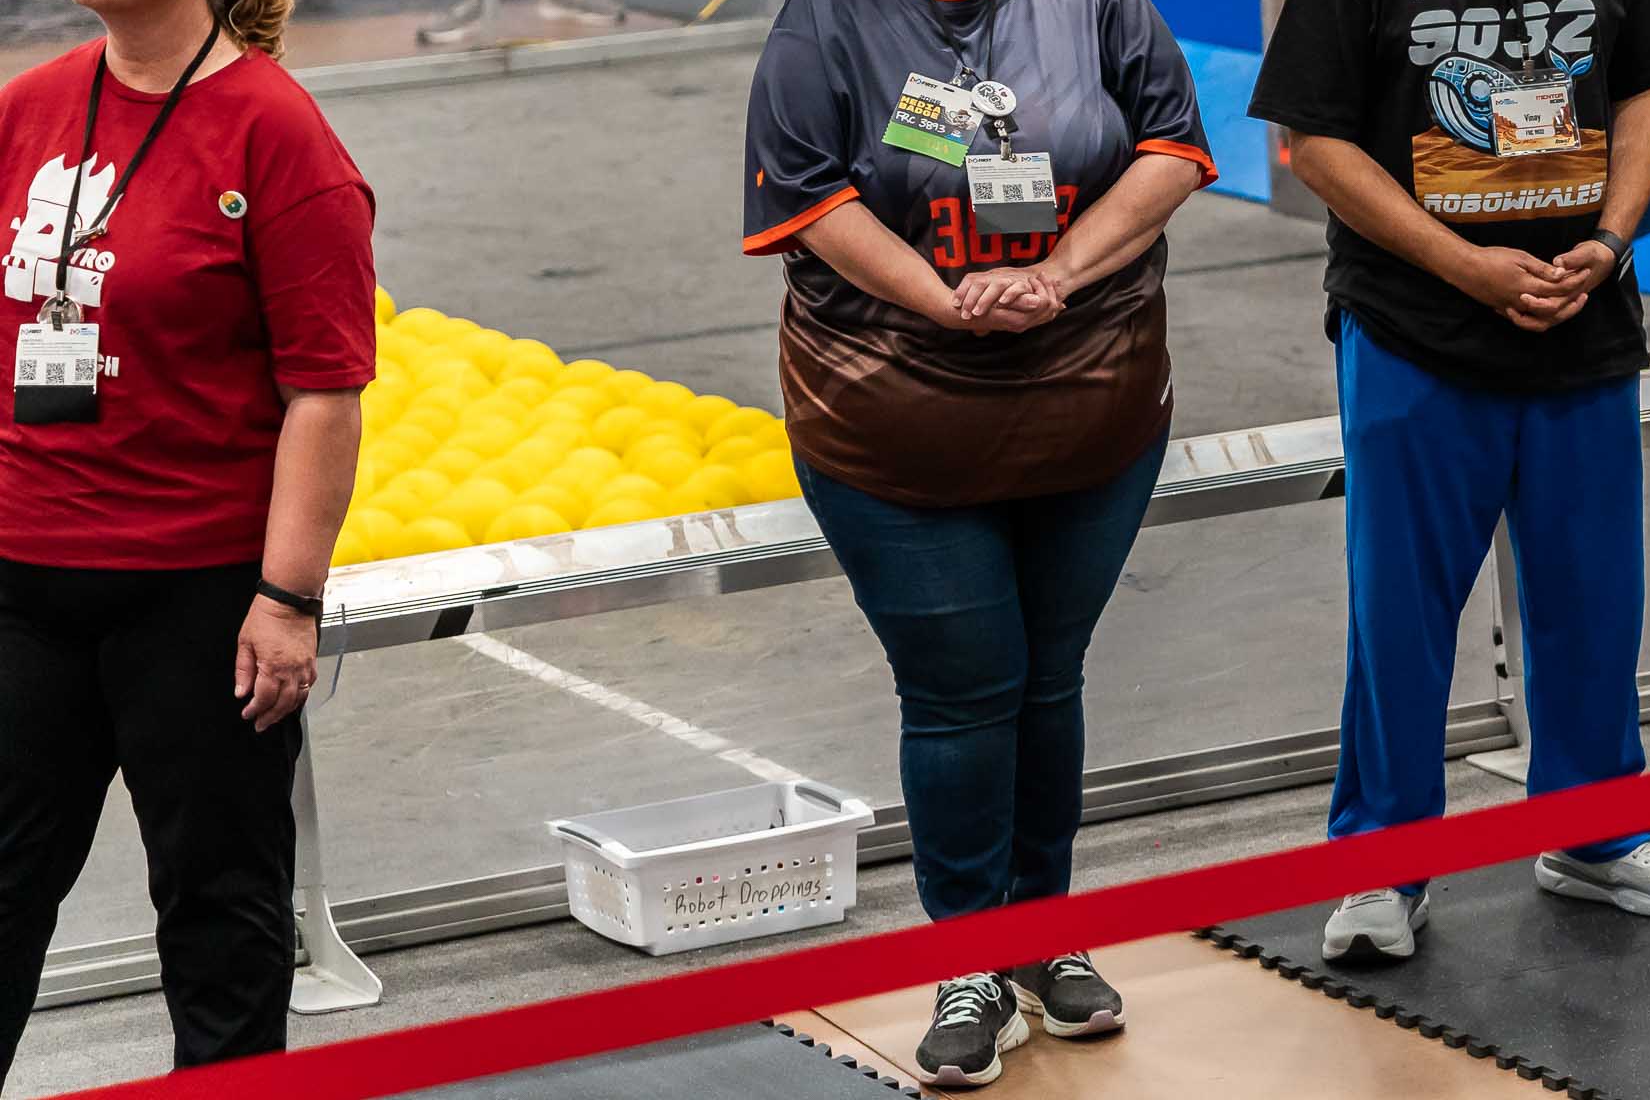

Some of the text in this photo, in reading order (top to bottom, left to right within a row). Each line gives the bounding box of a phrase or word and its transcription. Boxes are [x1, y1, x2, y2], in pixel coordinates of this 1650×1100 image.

[898, 102, 940, 120] BADGE
[901, 95, 941, 113] MEDIA
[896, 111, 946, 133] FRC 3893
[1424, 182, 1605, 214] ROBOWHALES
[675, 879, 822, 915] Robot Droppings
